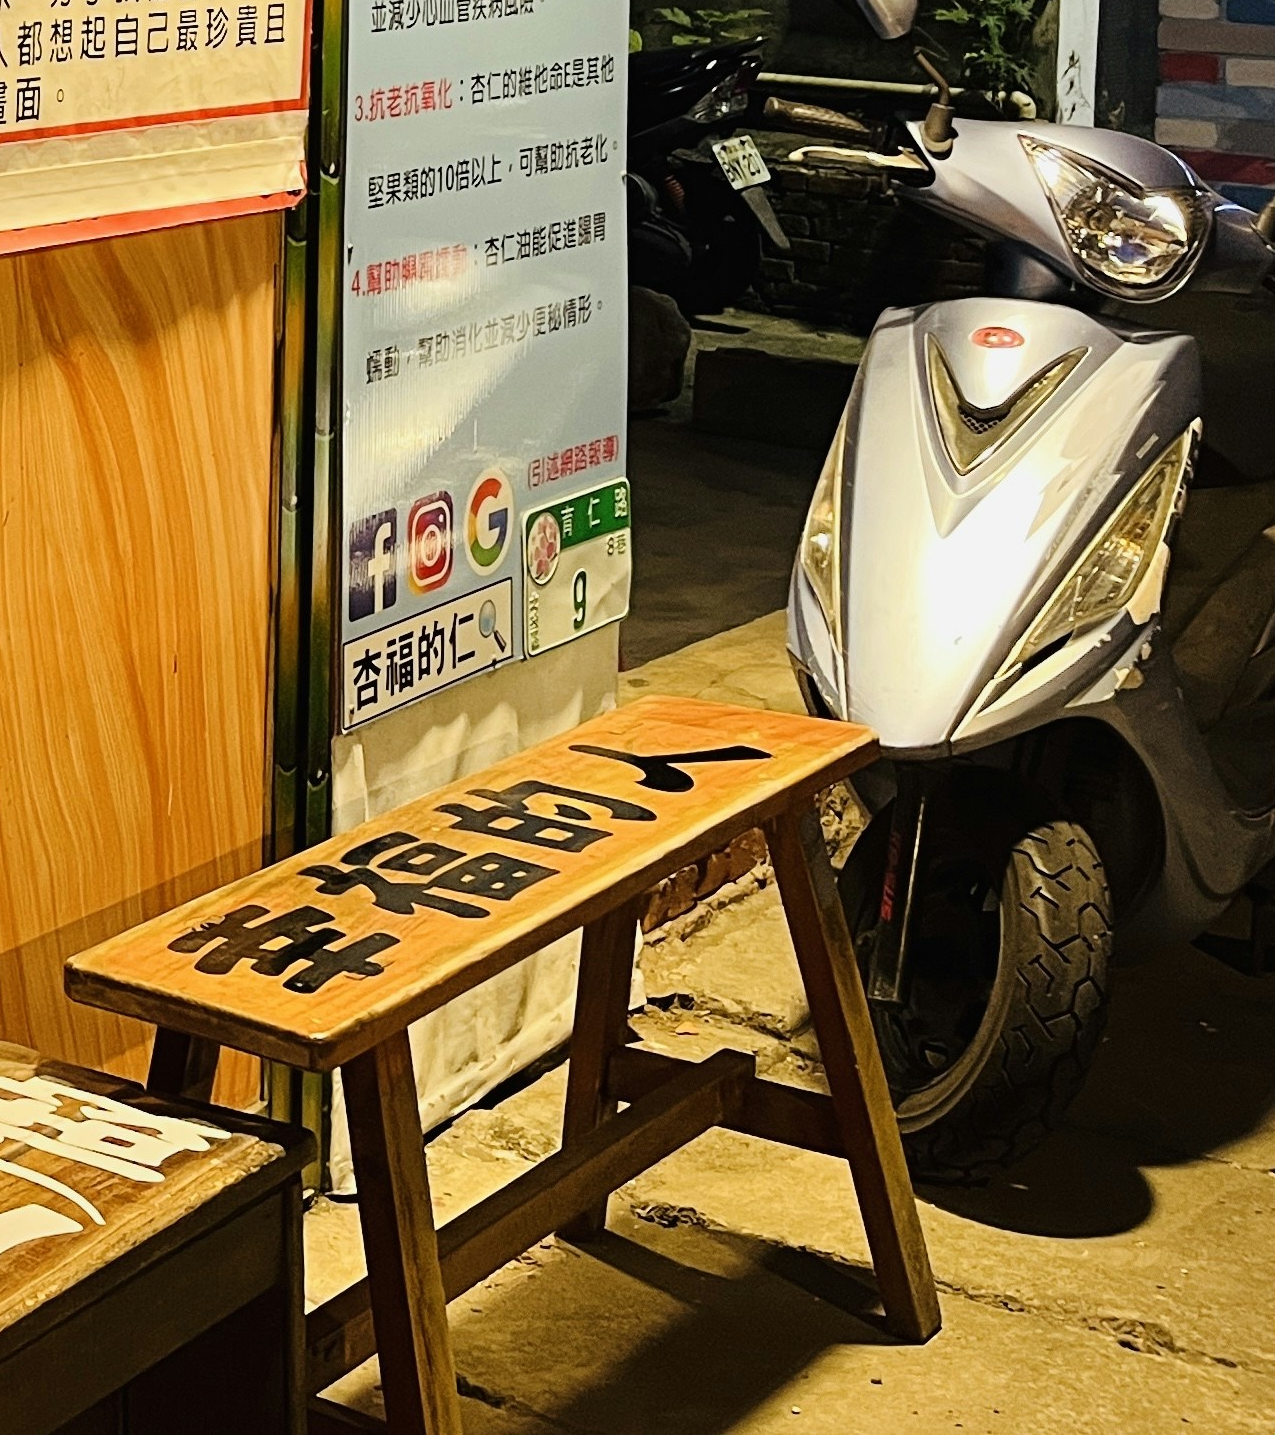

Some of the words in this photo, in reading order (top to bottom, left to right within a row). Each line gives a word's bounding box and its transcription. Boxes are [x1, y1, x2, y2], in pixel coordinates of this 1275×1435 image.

[573, 567, 588, 632] 9
[352, 611, 477, 713] 杏福的仁
[166, 743, 774, 995] 幸福的人
